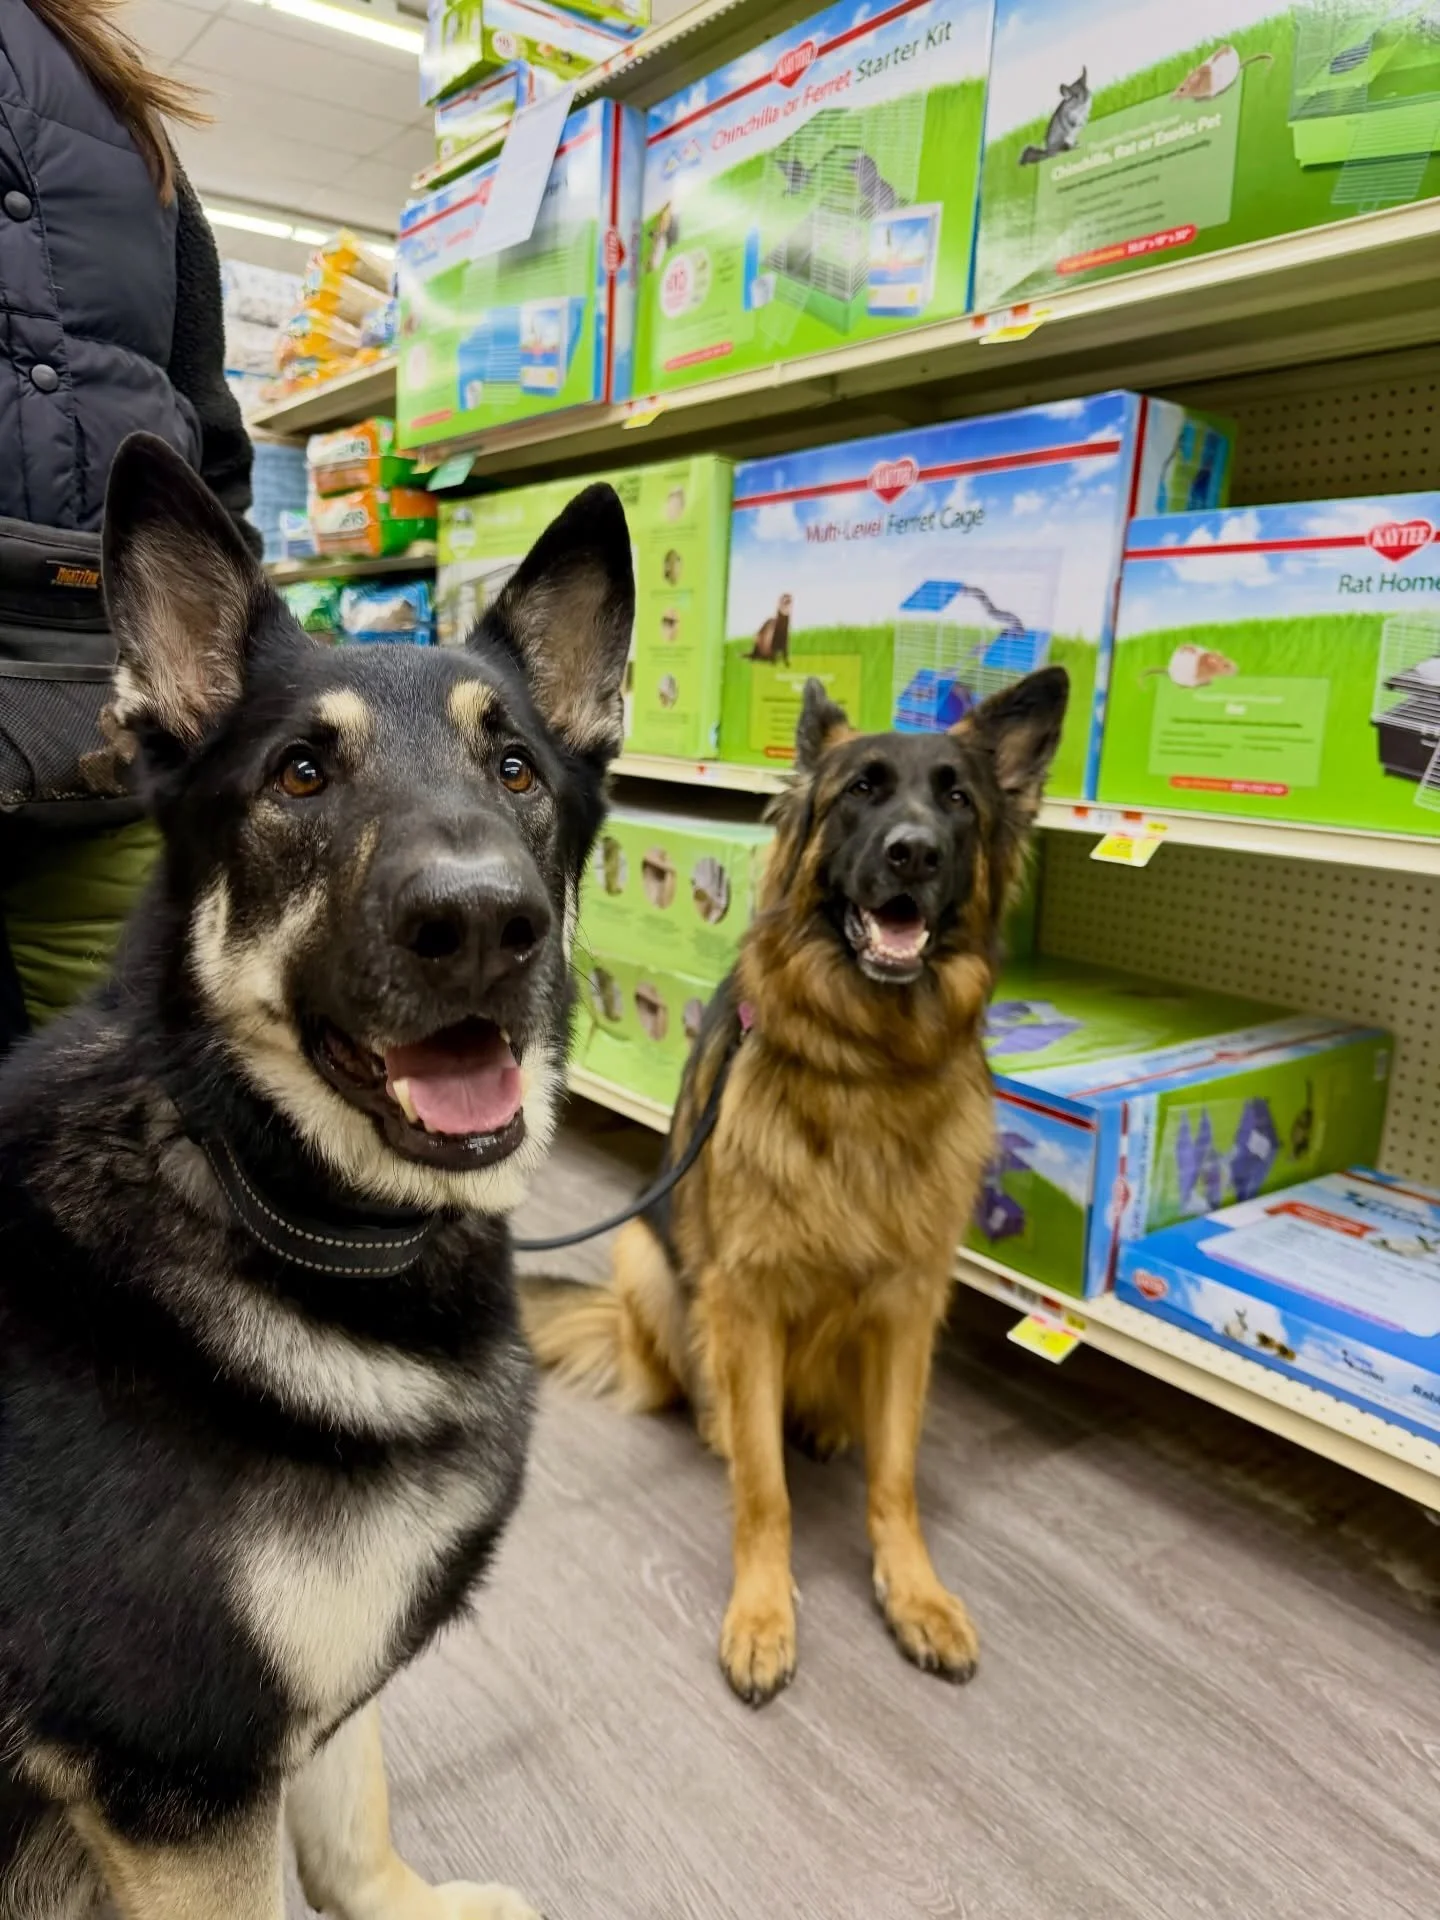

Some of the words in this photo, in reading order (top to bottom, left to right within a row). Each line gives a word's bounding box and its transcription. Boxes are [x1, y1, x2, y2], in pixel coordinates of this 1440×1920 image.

[711, 105, 780, 151] Chinchilla
[783, 101, 798, 117] or
[803, 69, 853, 108] Ferret
[855, 39, 919, 83] Starter
[925, 22, 952, 50] Kit
[805, 516, 882, 543] Multi-Level
[887, 509, 937, 535] Ferret
[940, 505, 985, 534] Cage
[1338, 573, 1373, 594] Rat
